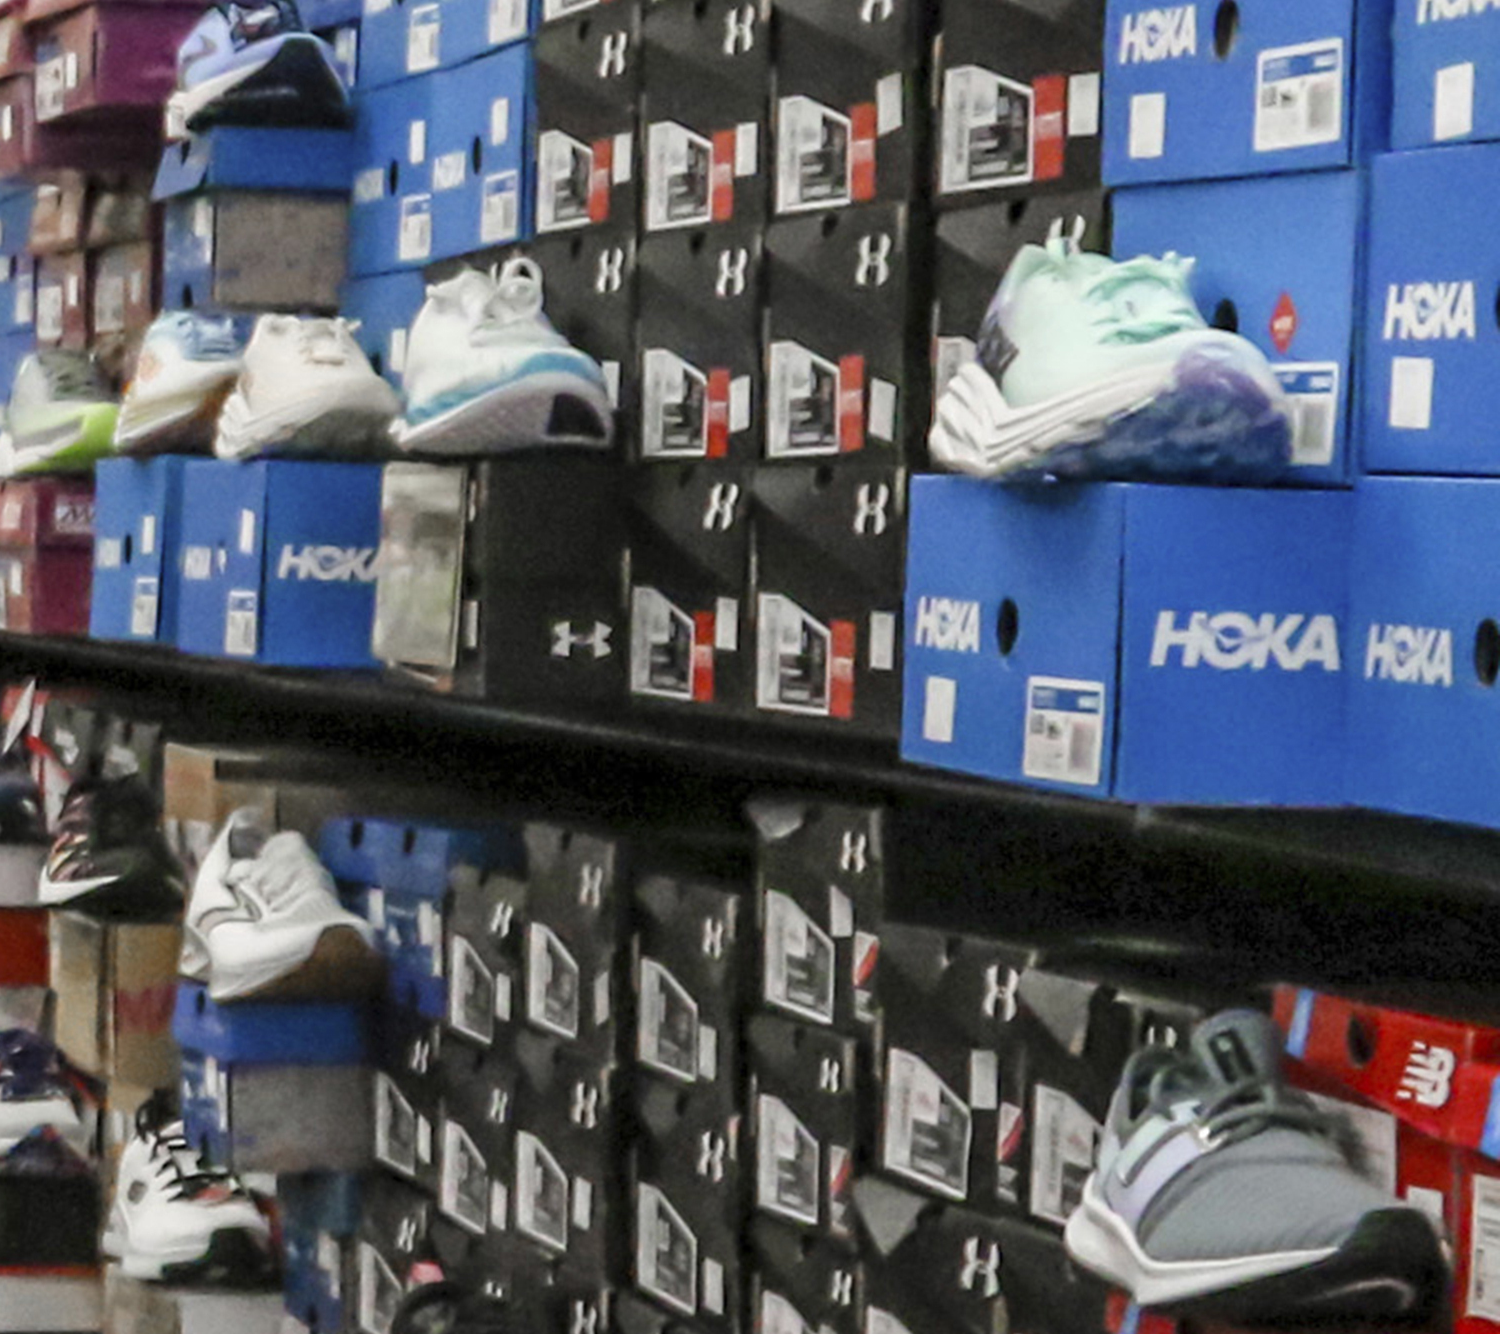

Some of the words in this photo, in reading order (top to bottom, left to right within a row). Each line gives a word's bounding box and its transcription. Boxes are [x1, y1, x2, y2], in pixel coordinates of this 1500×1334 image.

[1119, 5, 1196, 64] HOKA
[1384, 282, 1475, 340] HOKA
[277, 544, 380, 581] HOK
[915, 597, 979, 652] HOKA
[1150, 611, 1339, 670] HOKA
[1366, 625, 1452, 686] HOKA
